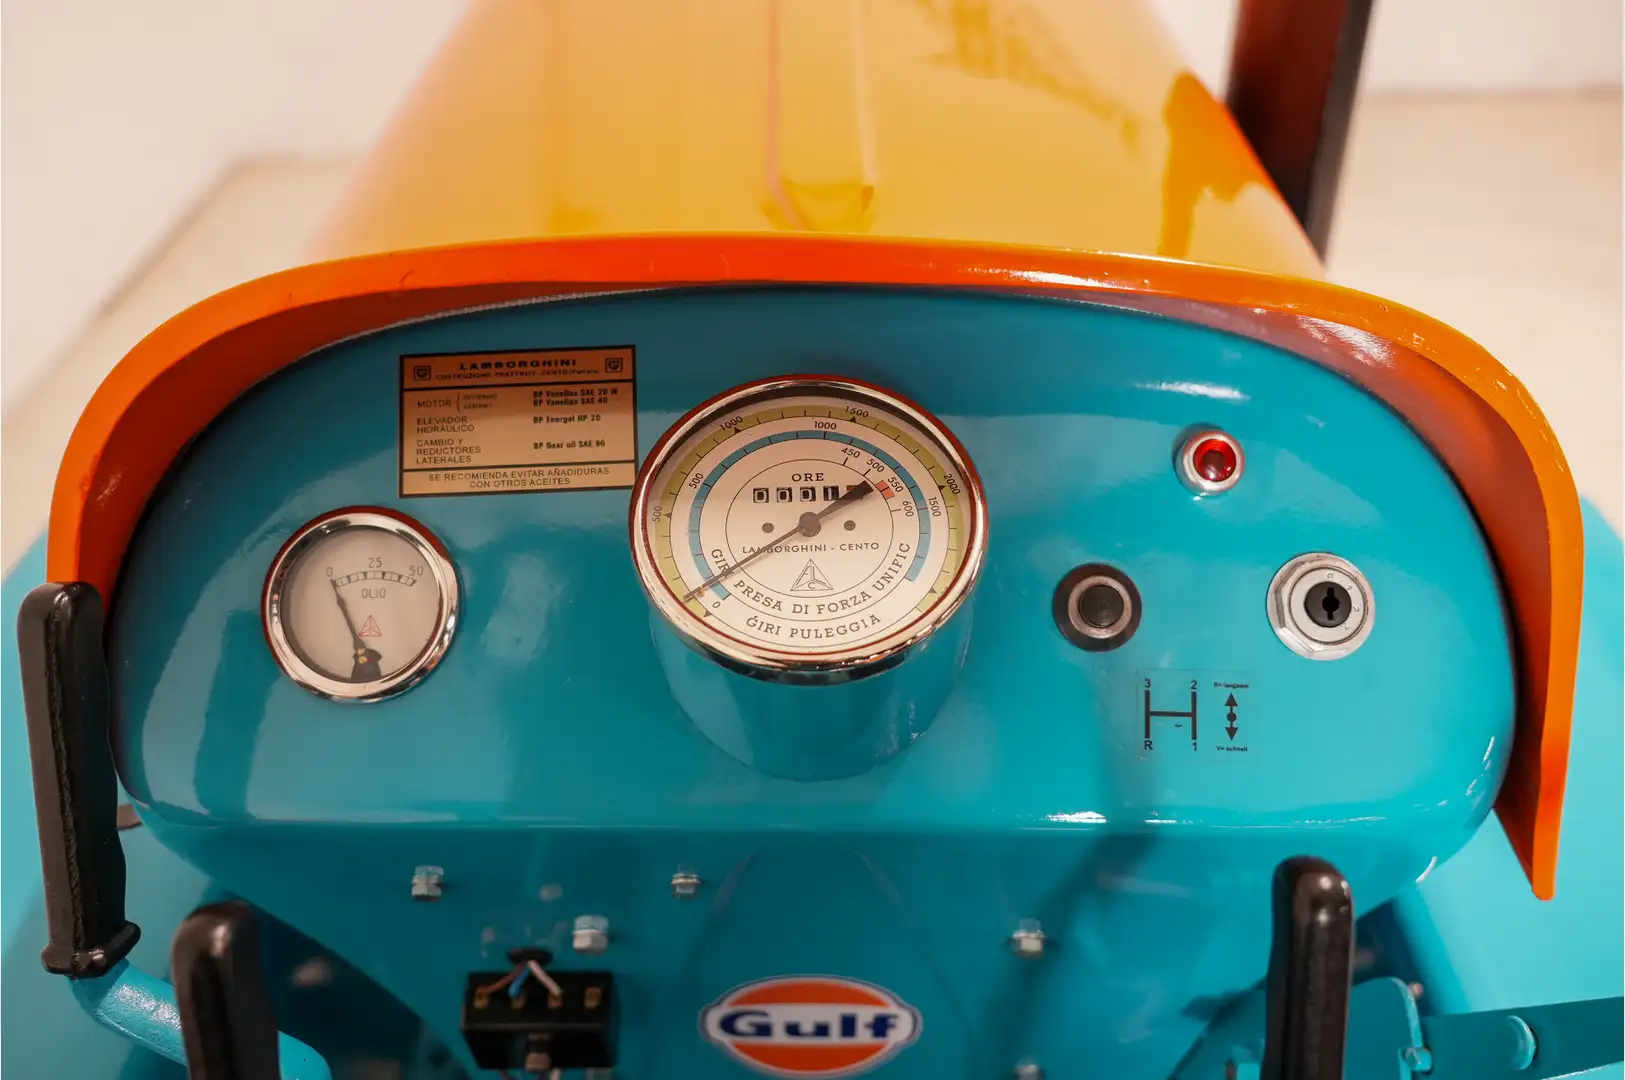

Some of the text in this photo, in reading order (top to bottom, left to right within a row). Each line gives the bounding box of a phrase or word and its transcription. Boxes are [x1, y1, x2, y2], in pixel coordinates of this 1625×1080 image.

[459, 359, 577, 370] LAMBORGHINI
[533, 390, 543, 398] BP
[580, 388, 595, 396] SAE
[597, 388, 608, 396] 20
[417, 399, 452, 409] MOTOR
[533, 399, 543, 407] BP
[580, 397, 595, 406] SAE
[844, 405, 869, 418] 1500
[416, 415, 468, 426] ELEVADOR
[533, 416, 543, 424] BP
[577, 414, 588, 422] HP
[590, 413, 601, 422] 20
[719, 415, 743, 432] 1000
[813, 420, 837, 431] 1000
[416, 437, 464, 448] CAMBIO Y
[533, 442, 544, 450] BP
[546, 441, 564, 450] Gear
[566, 440, 576, 449] oil
[578, 440, 593, 448] SAE
[415, 446, 482, 456] REDUCTORES
[841, 446, 861, 459] 450
[415, 455, 473, 465] LATERALES
[866, 458, 885, 473] 500
[428, 467, 610, 483] SE RECOMIENDA EVITAR AÑADIDURAS
[688, 472, 704, 490] 500
[791, 472, 825, 482] ORE
[469, 477, 571, 489] CON OTROS ACEITES
[887, 476, 904, 493] 550
[943, 473, 961, 495] 2000
[902, 500, 915, 517] 600
[928, 496, 942, 517] 1500
[651, 505, 663, 523] 500
[839, 542, 880, 551] CENTO
[368, 557, 383, 569] 25
[326, 566, 334, 578] 0
[409, 565, 424, 577] 50
[711, 542, 911, 615] GIR PRESA DI FORZA UNIFIC
[361, 587, 387, 600] OLIO
[711, 600, 722, 609] 0
[789, 614, 882, 640] PULEGGIA
[1144, 678, 1151, 689] 3
[1190, 679, 1198, 690] 2
[1144, 740, 1154, 751] R
[1191, 741, 1198, 752] 1
[719, 1009, 899, 1039] Gulf
